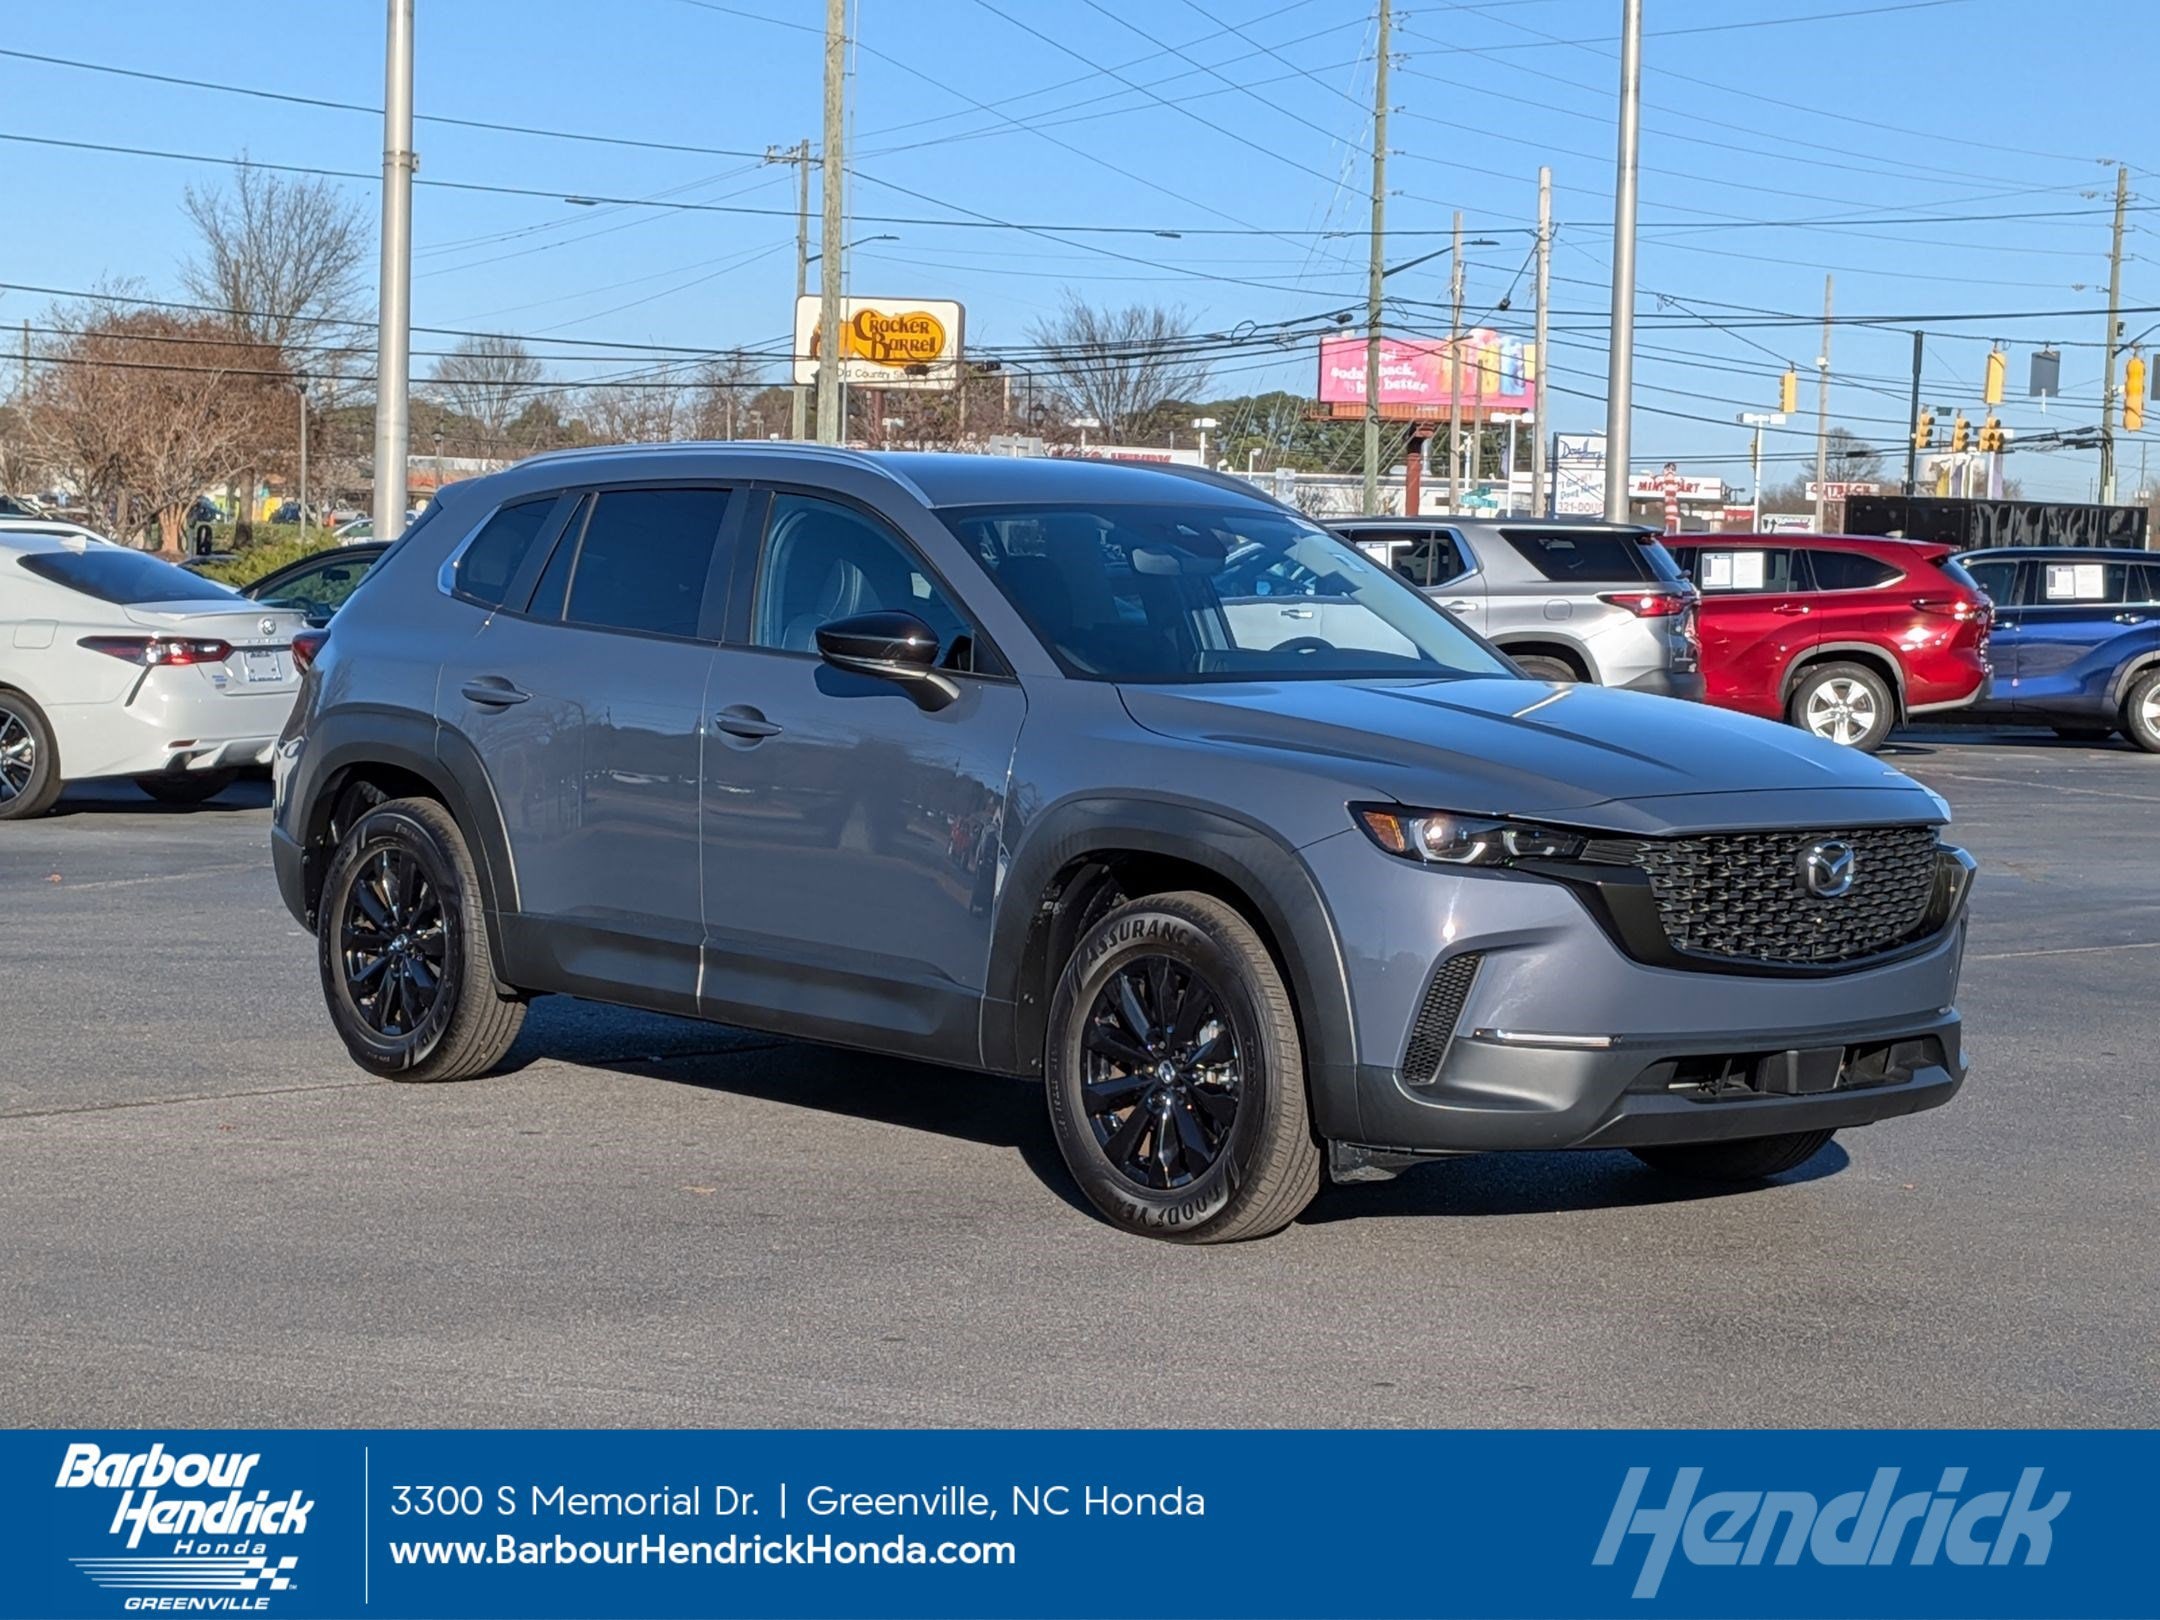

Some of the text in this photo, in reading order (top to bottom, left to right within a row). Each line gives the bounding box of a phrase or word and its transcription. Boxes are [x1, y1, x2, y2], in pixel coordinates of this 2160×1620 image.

[853, 310, 929, 341] Cracker
[871, 331, 936, 359] Barrel
[837, 368, 851, 378] Od
[1103, 1184, 1221, 1228] GOODYEA
